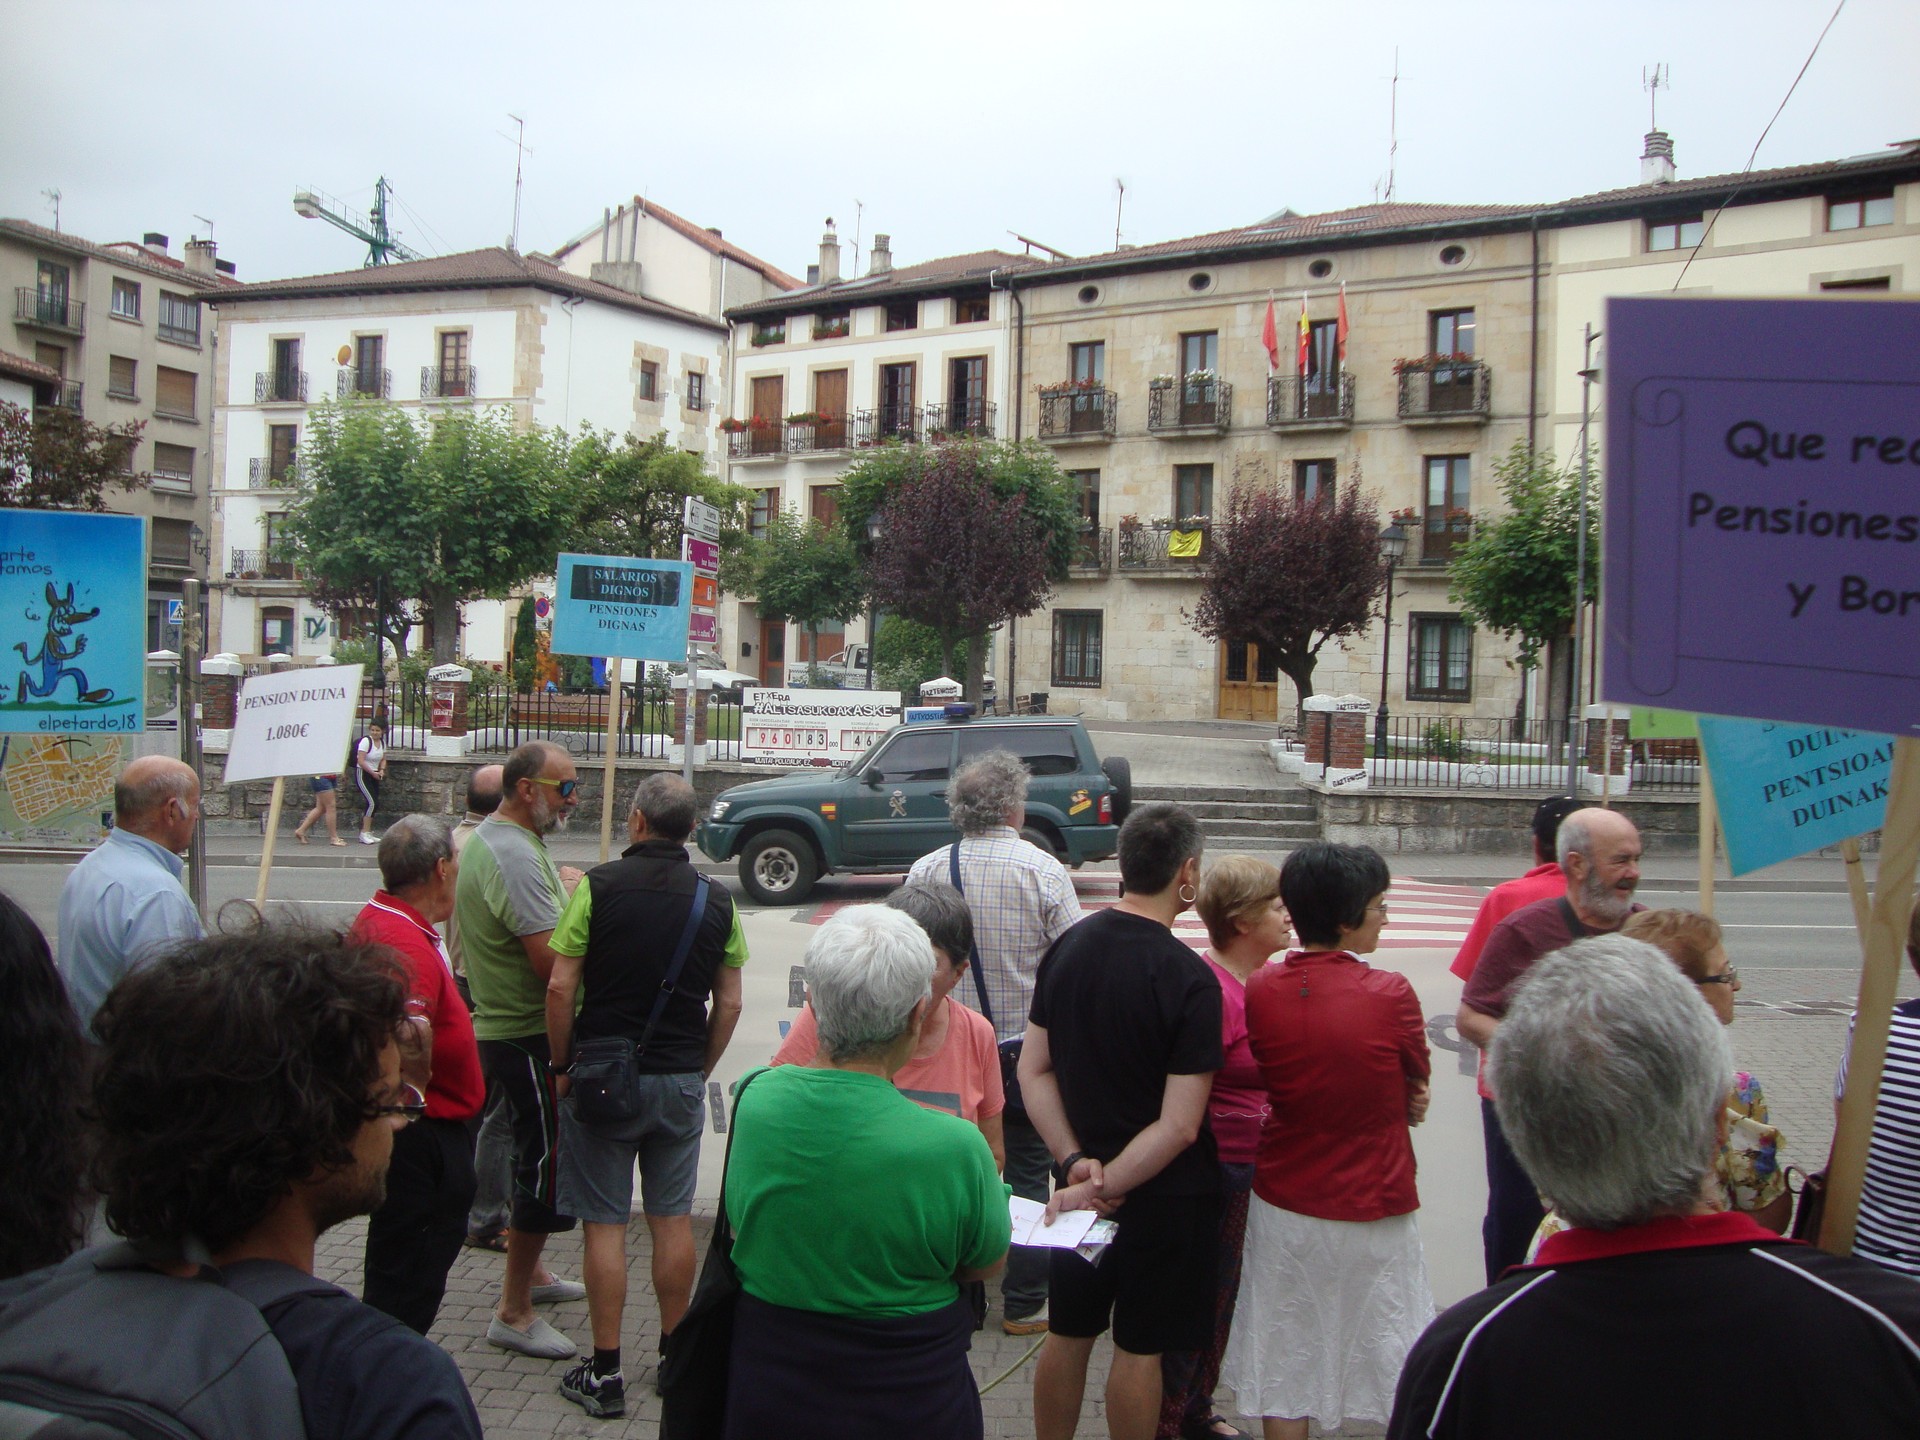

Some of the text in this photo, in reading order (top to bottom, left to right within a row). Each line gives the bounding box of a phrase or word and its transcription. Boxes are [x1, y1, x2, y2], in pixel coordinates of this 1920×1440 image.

[1725, 419, 1826, 468] Que
[1689, 491, 1920, 543] Pensiones
[594, 569, 658, 584] SALARIOS
[600, 584, 650, 598] DIGNOS
[1787, 581, 1817, 618] y
[589, 603, 658, 619] PENSIONES
[598, 618, 646, 632] DIGNAS
[244, 687, 347, 710] PENSION DUINA
[753, 691, 791, 703] ETXERA
[265, 723, 310, 741] 1.080€
[760, 731, 792, 744] 960
[796, 734, 825, 746] 183
[1792, 778, 1890, 828] DUINAK
